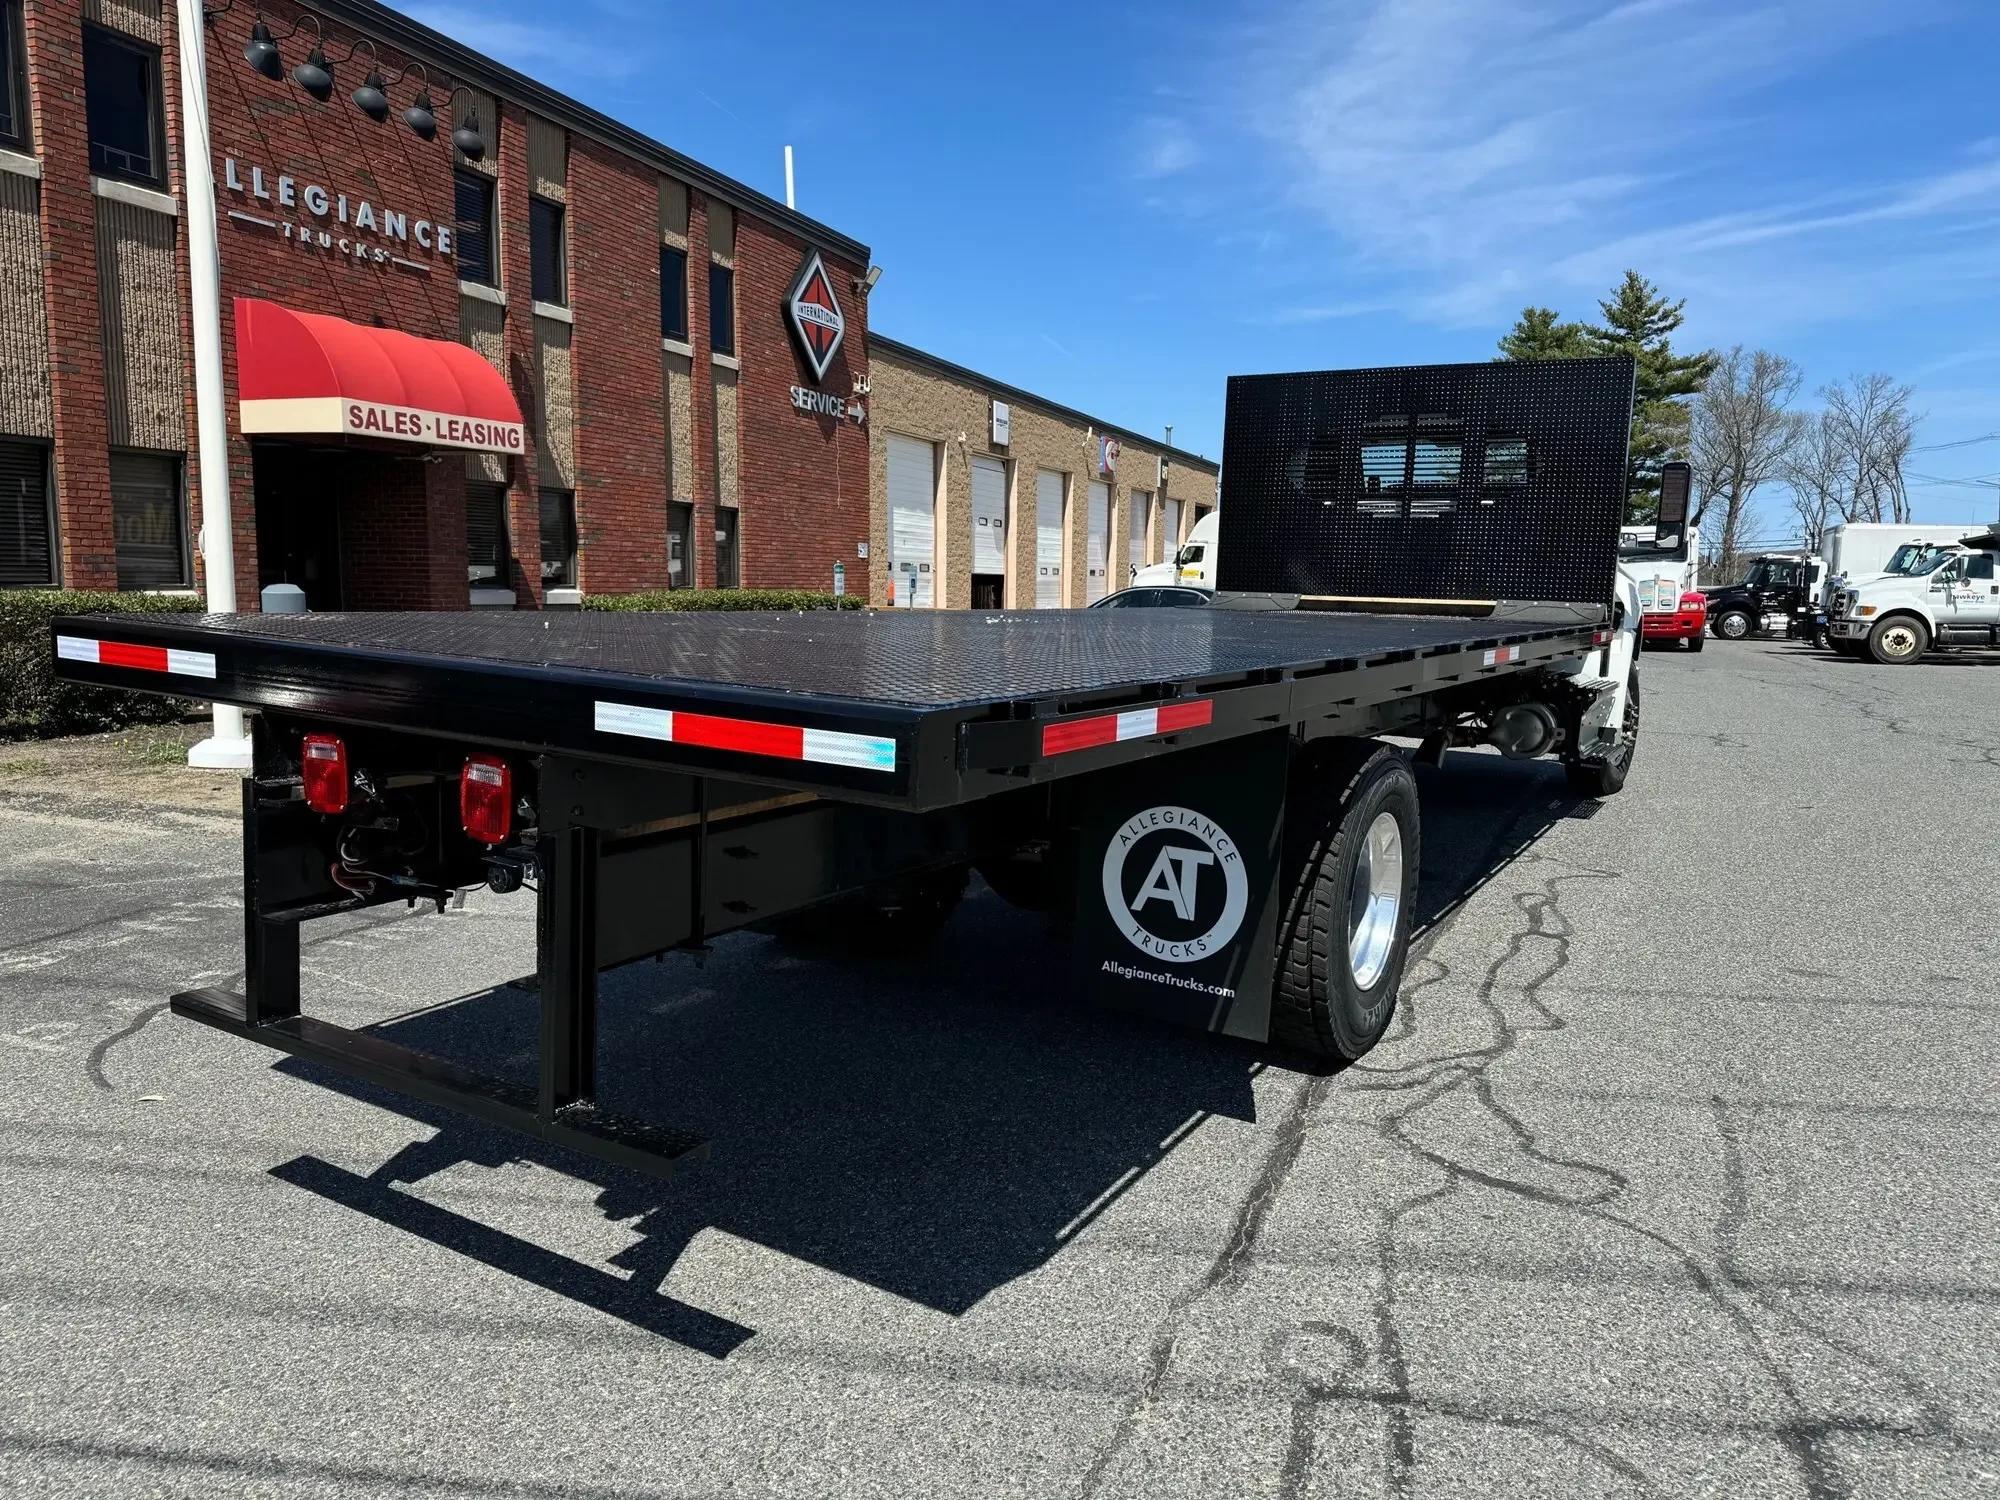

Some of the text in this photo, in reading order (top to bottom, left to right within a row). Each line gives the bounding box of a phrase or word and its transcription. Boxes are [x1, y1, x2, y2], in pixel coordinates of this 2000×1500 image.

[212, 157, 452, 254] LLEGIANCE
[282, 221, 384, 263] TRUCKS
[798, 304, 839, 327] INTERNATIONAL
[790, 385, 845, 419] SERVICE
[349, 404, 520, 449] SALES LEASING
[1119, 811, 1237, 863] ALLEGIANCE
[1130, 845, 1214, 921] AT
[1101, 960, 1235, 998] AllegianceTrucks.com
